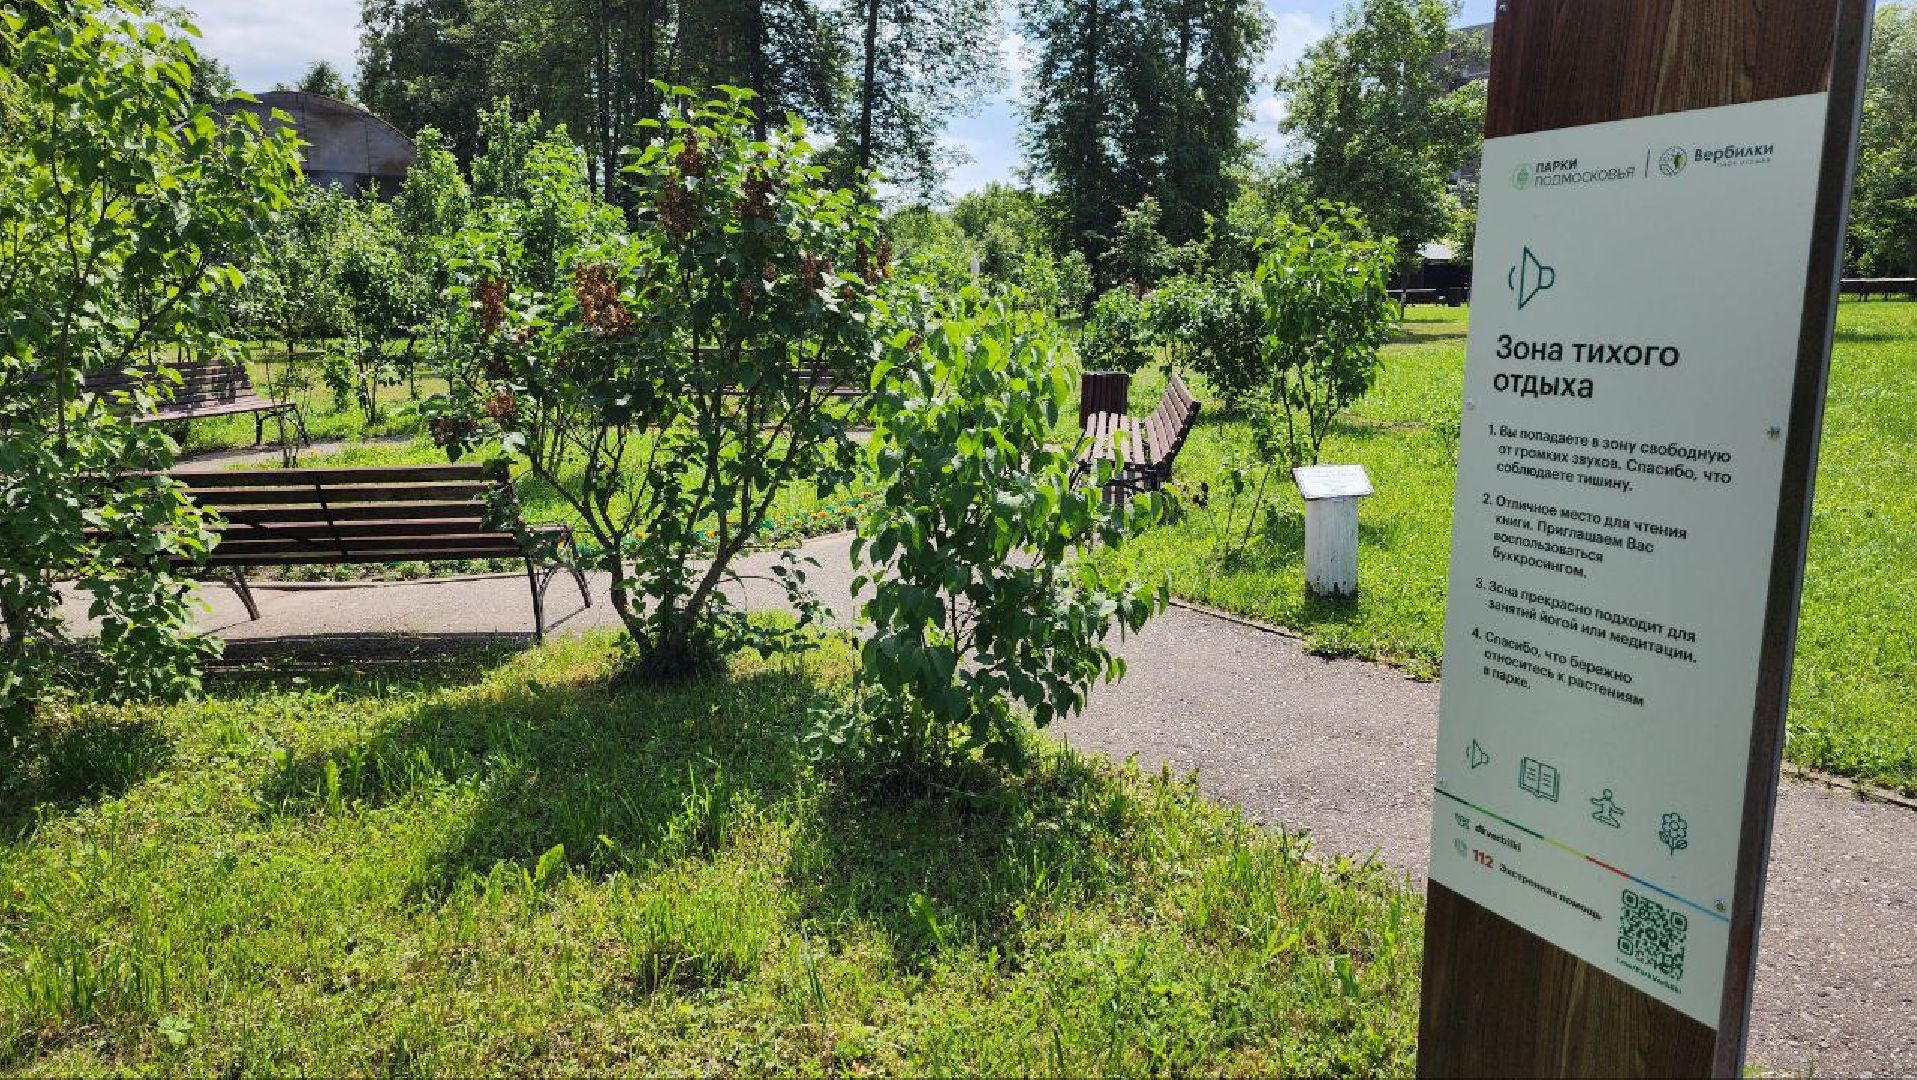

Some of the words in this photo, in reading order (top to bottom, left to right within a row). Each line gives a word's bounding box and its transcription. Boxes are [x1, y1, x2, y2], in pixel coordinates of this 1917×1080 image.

[1535, 158, 1578, 173] ПАРКИ
[1694, 144, 1774, 163] Вербилки
[1534, 166, 1635, 187] ПОДМОСКОВЬЯ
[1496, 334, 1563, 361] Зона
[1572, 342, 1681, 366] тихого
[1493, 373, 1594, 399] отдыха
[1488, 424, 1497, 436] 1.
[1499, 425, 1517, 438] Вы
[1520, 430, 1588, 447] попадаете
[1592, 437, 1599, 447] в
[1602, 439, 1636, 454] зону
[1640, 442, 1732, 464] свободную
[1496, 461, 1574, 483] соблюдаете
[1577, 473, 1633, 492] тишину.
[1498, 445, 1512, 454] от
[1514, 446, 1568, 463] громких
[1572, 455, 1621, 470] звуков.
[1626, 458, 1698, 481] Спасибо,
[1704, 470, 1732, 484] что
[1482, 493, 1492, 505] 2.
[1496, 495, 1557, 516] Отличное
[1560, 508, 1601, 524] место
[1603, 516, 1630, 530] для
[1634, 520, 1687, 540] чтения
[1494, 532, 1603, 563] воспользоваться
[1496, 515, 1533, 531] книги.
[1538, 520, 1623, 549] Приглашаем
[1626, 537, 1654, 553] Вас
[1493, 545, 1587, 579] буккросингом.
[1475, 578, 1486, 590] 3.
[1489, 580, 1518, 598] Зона
[1521, 589, 1592, 616] прекрасно
[1595, 608, 1663, 634] подходит
[1667, 627, 1696, 643] для
[1488, 599, 1536, 620] занятий
[1539, 612, 1578, 631] йогой
[1580, 623, 1606, 640] или
[1610, 631, 1697, 664] медитации.
[1472, 627, 1482, 640] 4.
[1485, 631, 1542, 658] Спасибо,
[1544, 650, 1567, 665] что
[1570, 656, 1633, 684] бережно
[1484, 666, 1490, 676] в
[1492, 669, 1531, 690] парке.
[1484, 650, 1554, 679] относитесь
[1557, 671, 1564, 682] к
[1568, 674, 1645, 707] растениям
[1472, 849, 1493, 868] 112
